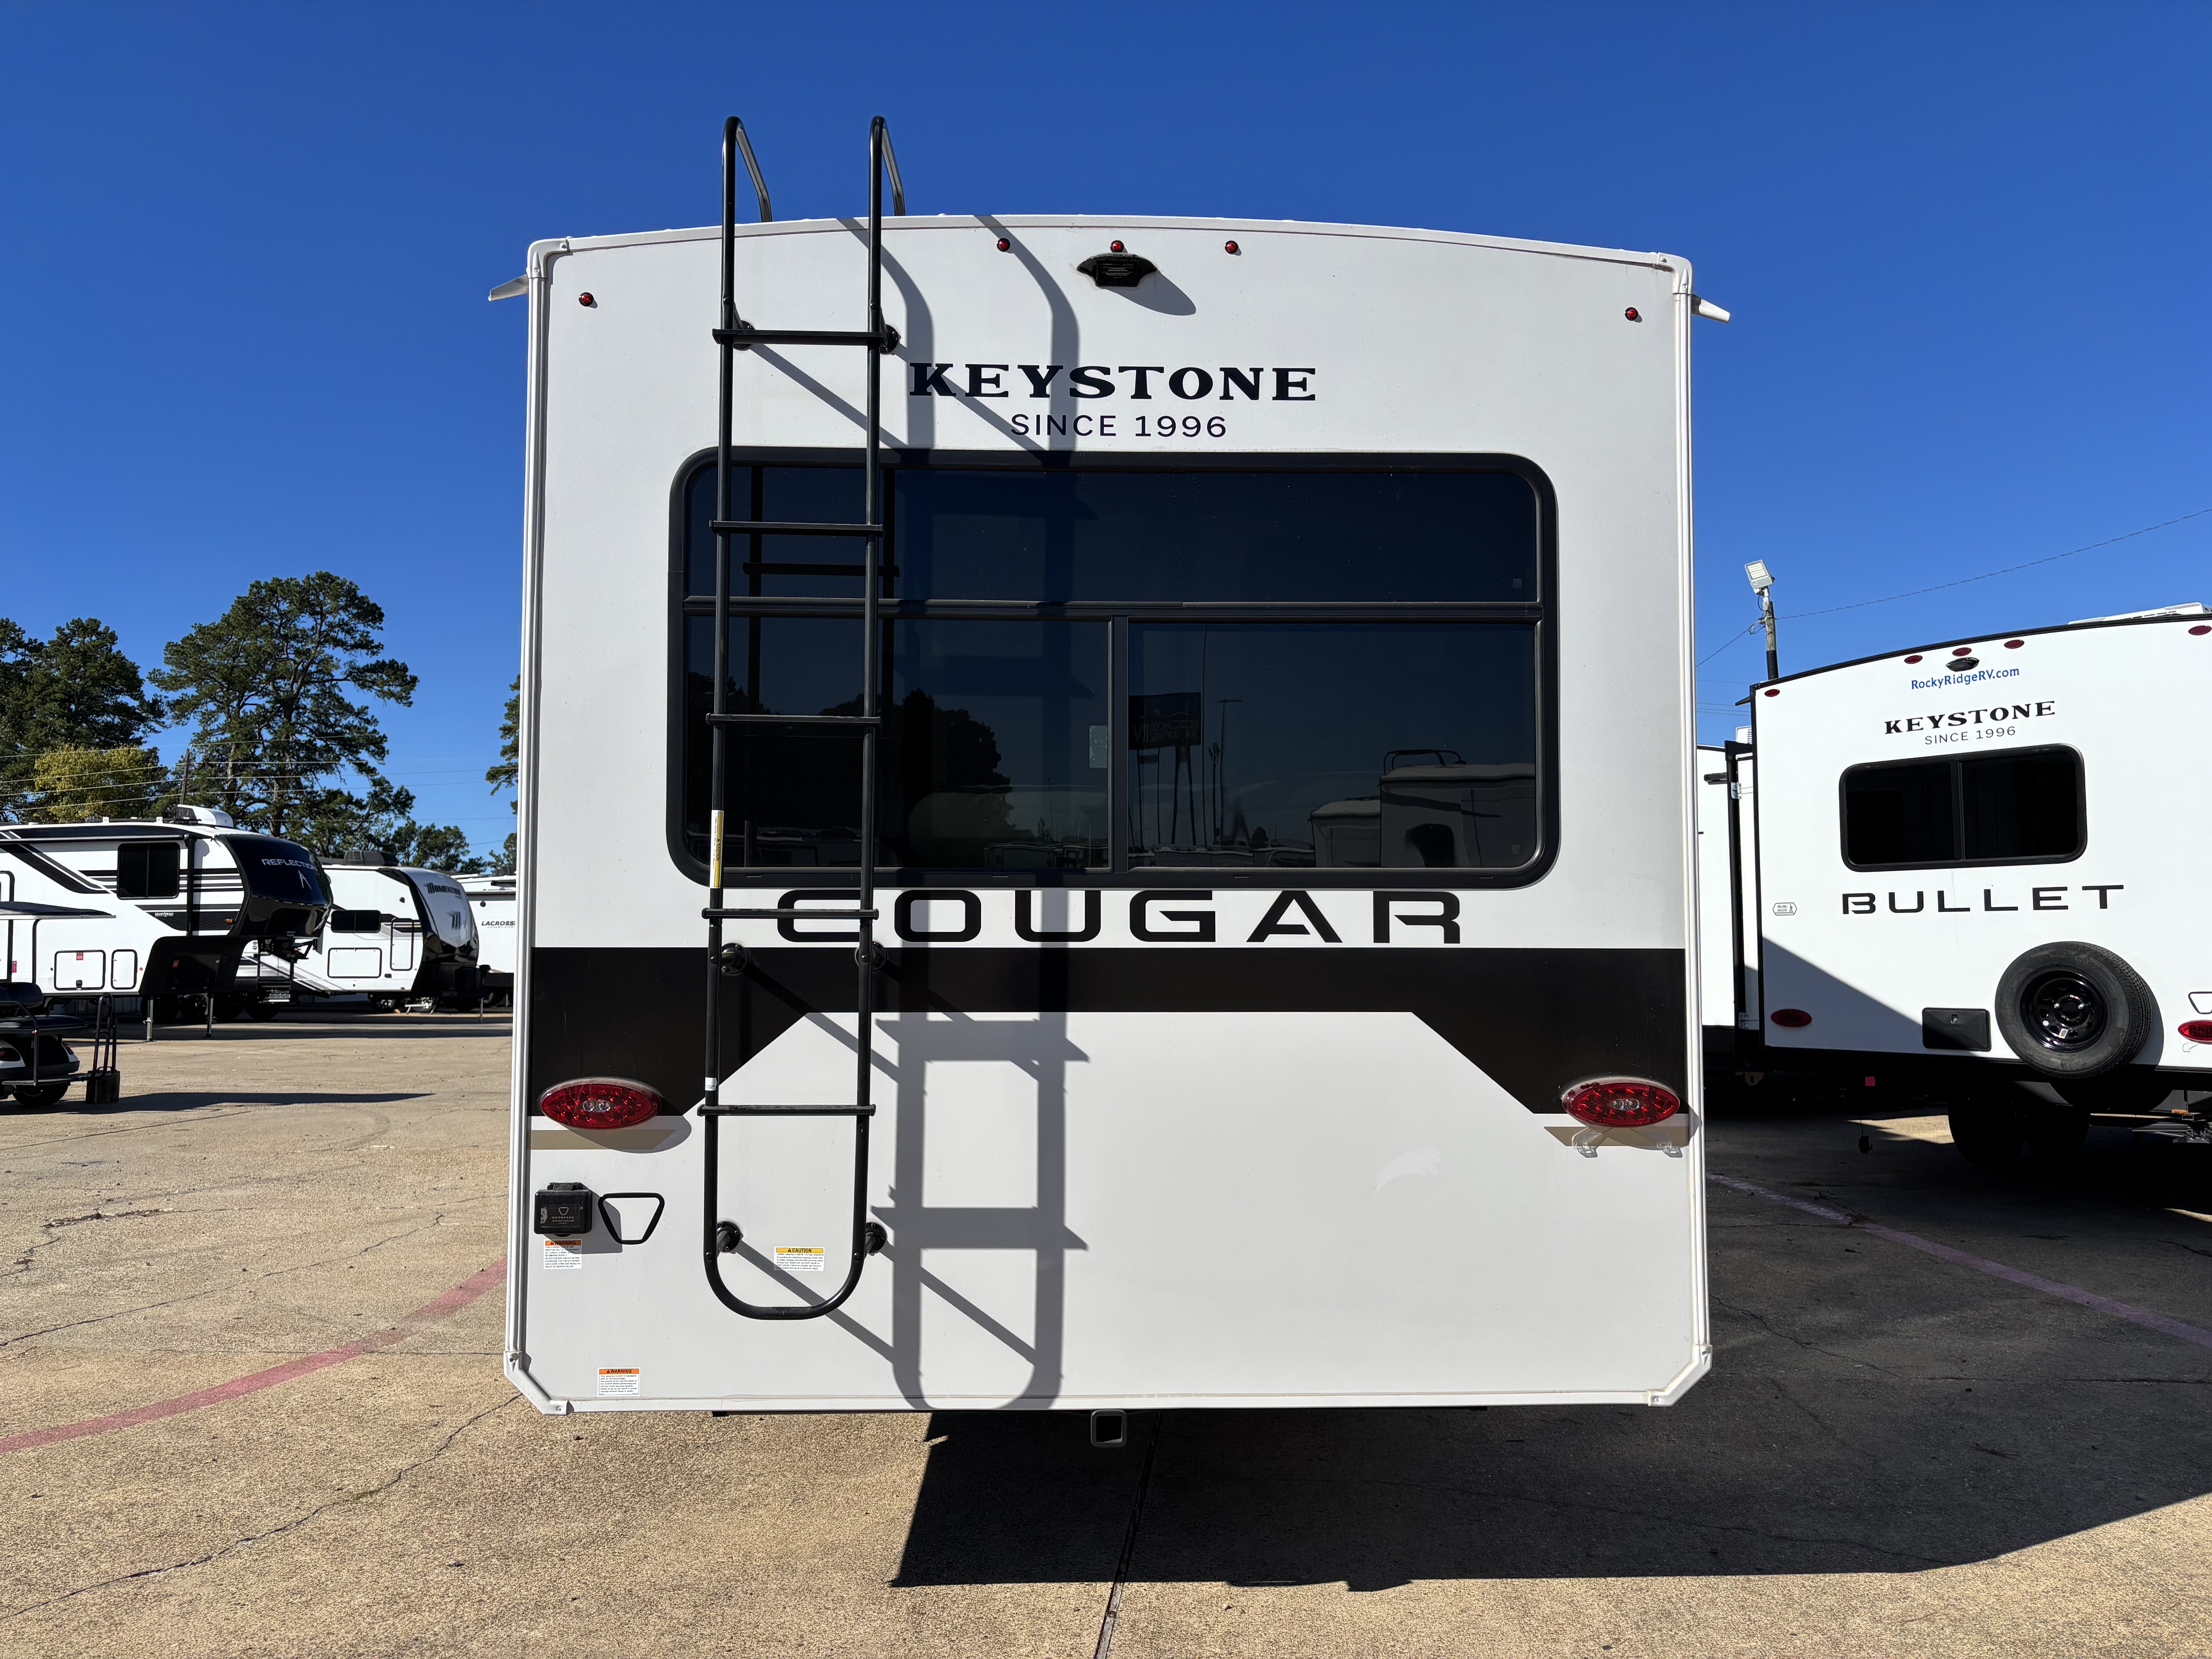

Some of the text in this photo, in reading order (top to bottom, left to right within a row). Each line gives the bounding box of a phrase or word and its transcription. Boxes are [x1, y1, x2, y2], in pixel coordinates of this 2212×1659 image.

[909, 362, 1316, 401] KEYSTONE
[1011, 414, 1226, 438] SINCE 1996
[1911, 667, 2020, 690] RockyRidgeRV.com
[1884, 701, 2055, 735] KEYSTONE
[1925, 726, 2016, 745] SINCE 1996
[261, 859, 318, 871] REFLECTION
[1842, 884, 2124, 914] BULLET
[777, 890, 1460, 944] COUGAR
